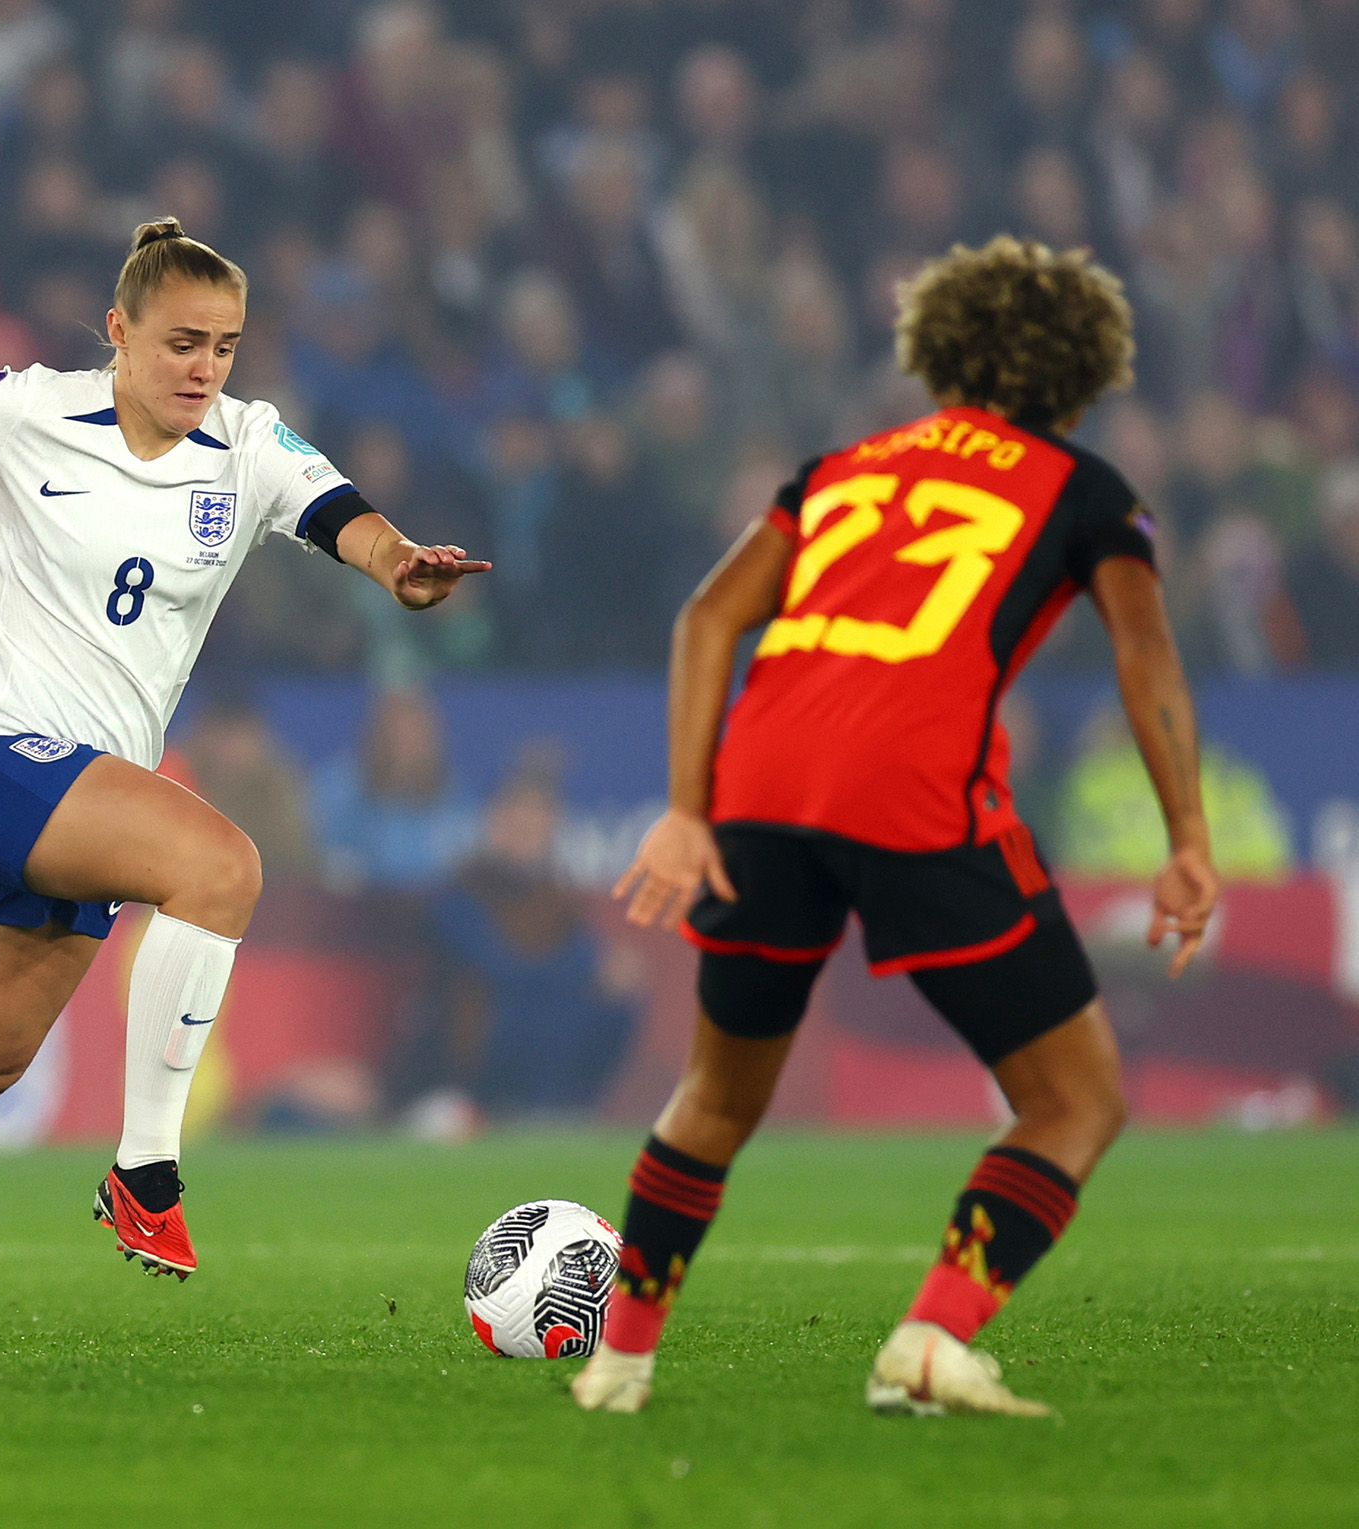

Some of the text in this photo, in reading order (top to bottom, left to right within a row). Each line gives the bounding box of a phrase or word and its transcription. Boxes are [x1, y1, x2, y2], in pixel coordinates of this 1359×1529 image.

[306, 465, 334, 482] FOUN
[194, 558, 215, 566] OCTOBER
[757, 473, 1025, 662] 23
[106, 556, 154, 626] 8
